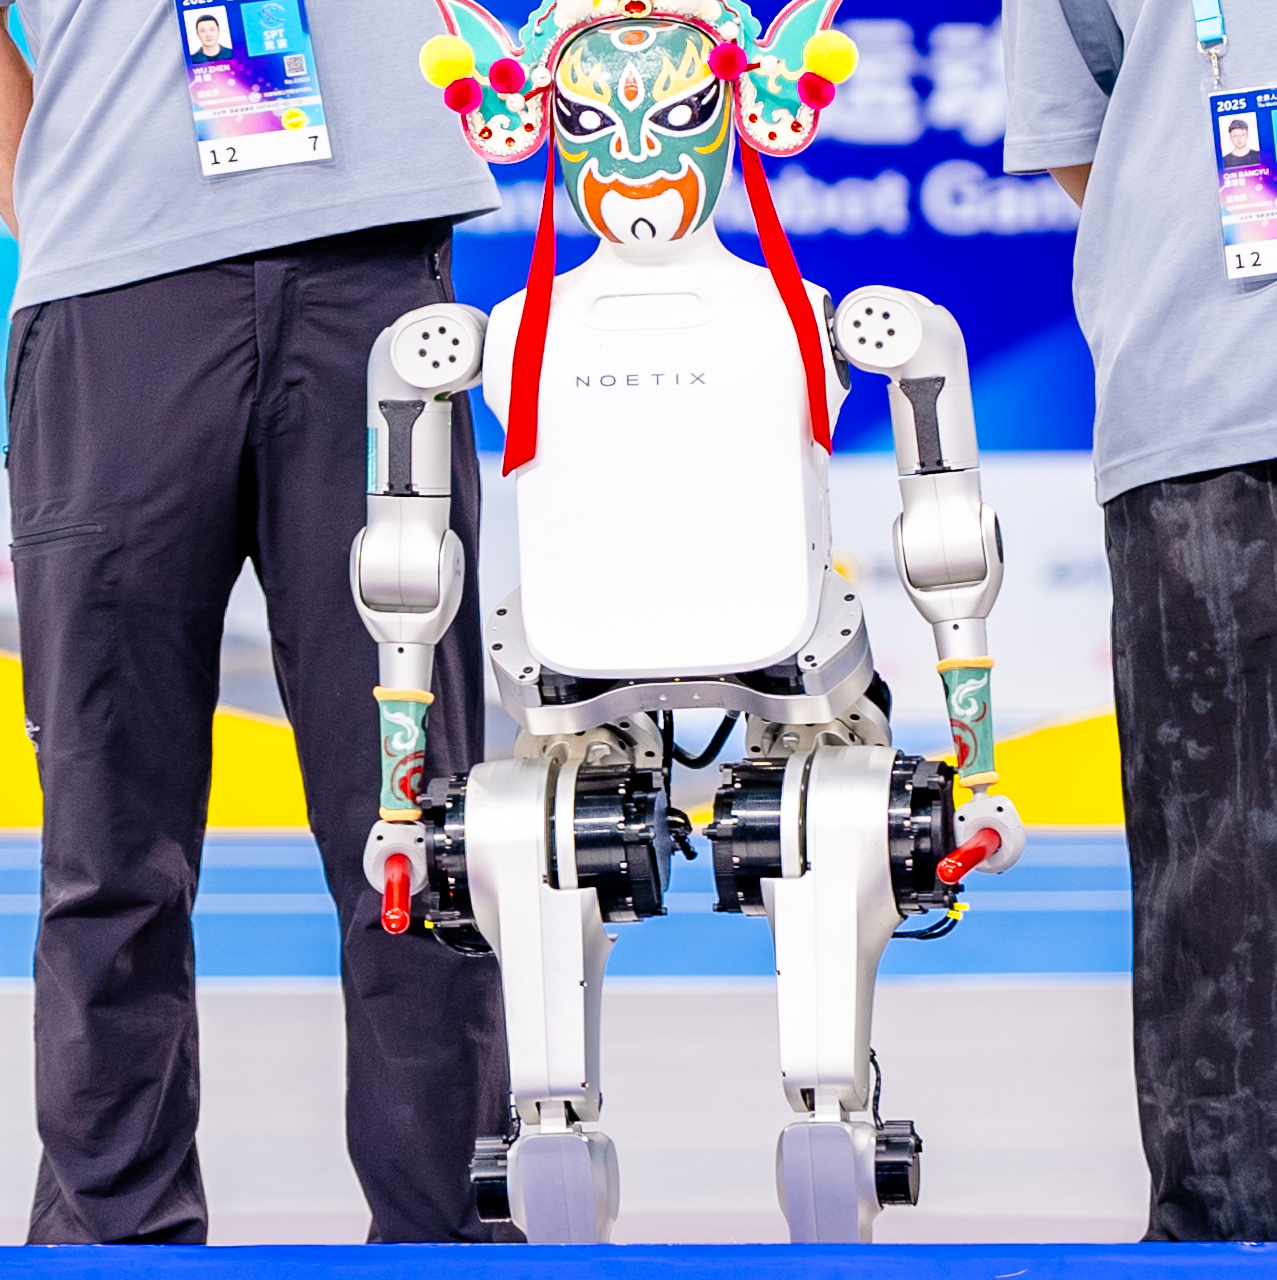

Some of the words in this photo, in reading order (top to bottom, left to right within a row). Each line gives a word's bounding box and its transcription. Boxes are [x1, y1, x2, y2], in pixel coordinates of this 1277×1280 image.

[263, 28, 285, 41] SPT
[1216, 97, 1247, 113] 2025
[308, 135, 319, 151] 7
[575, 372, 706, 388] NOETIX
